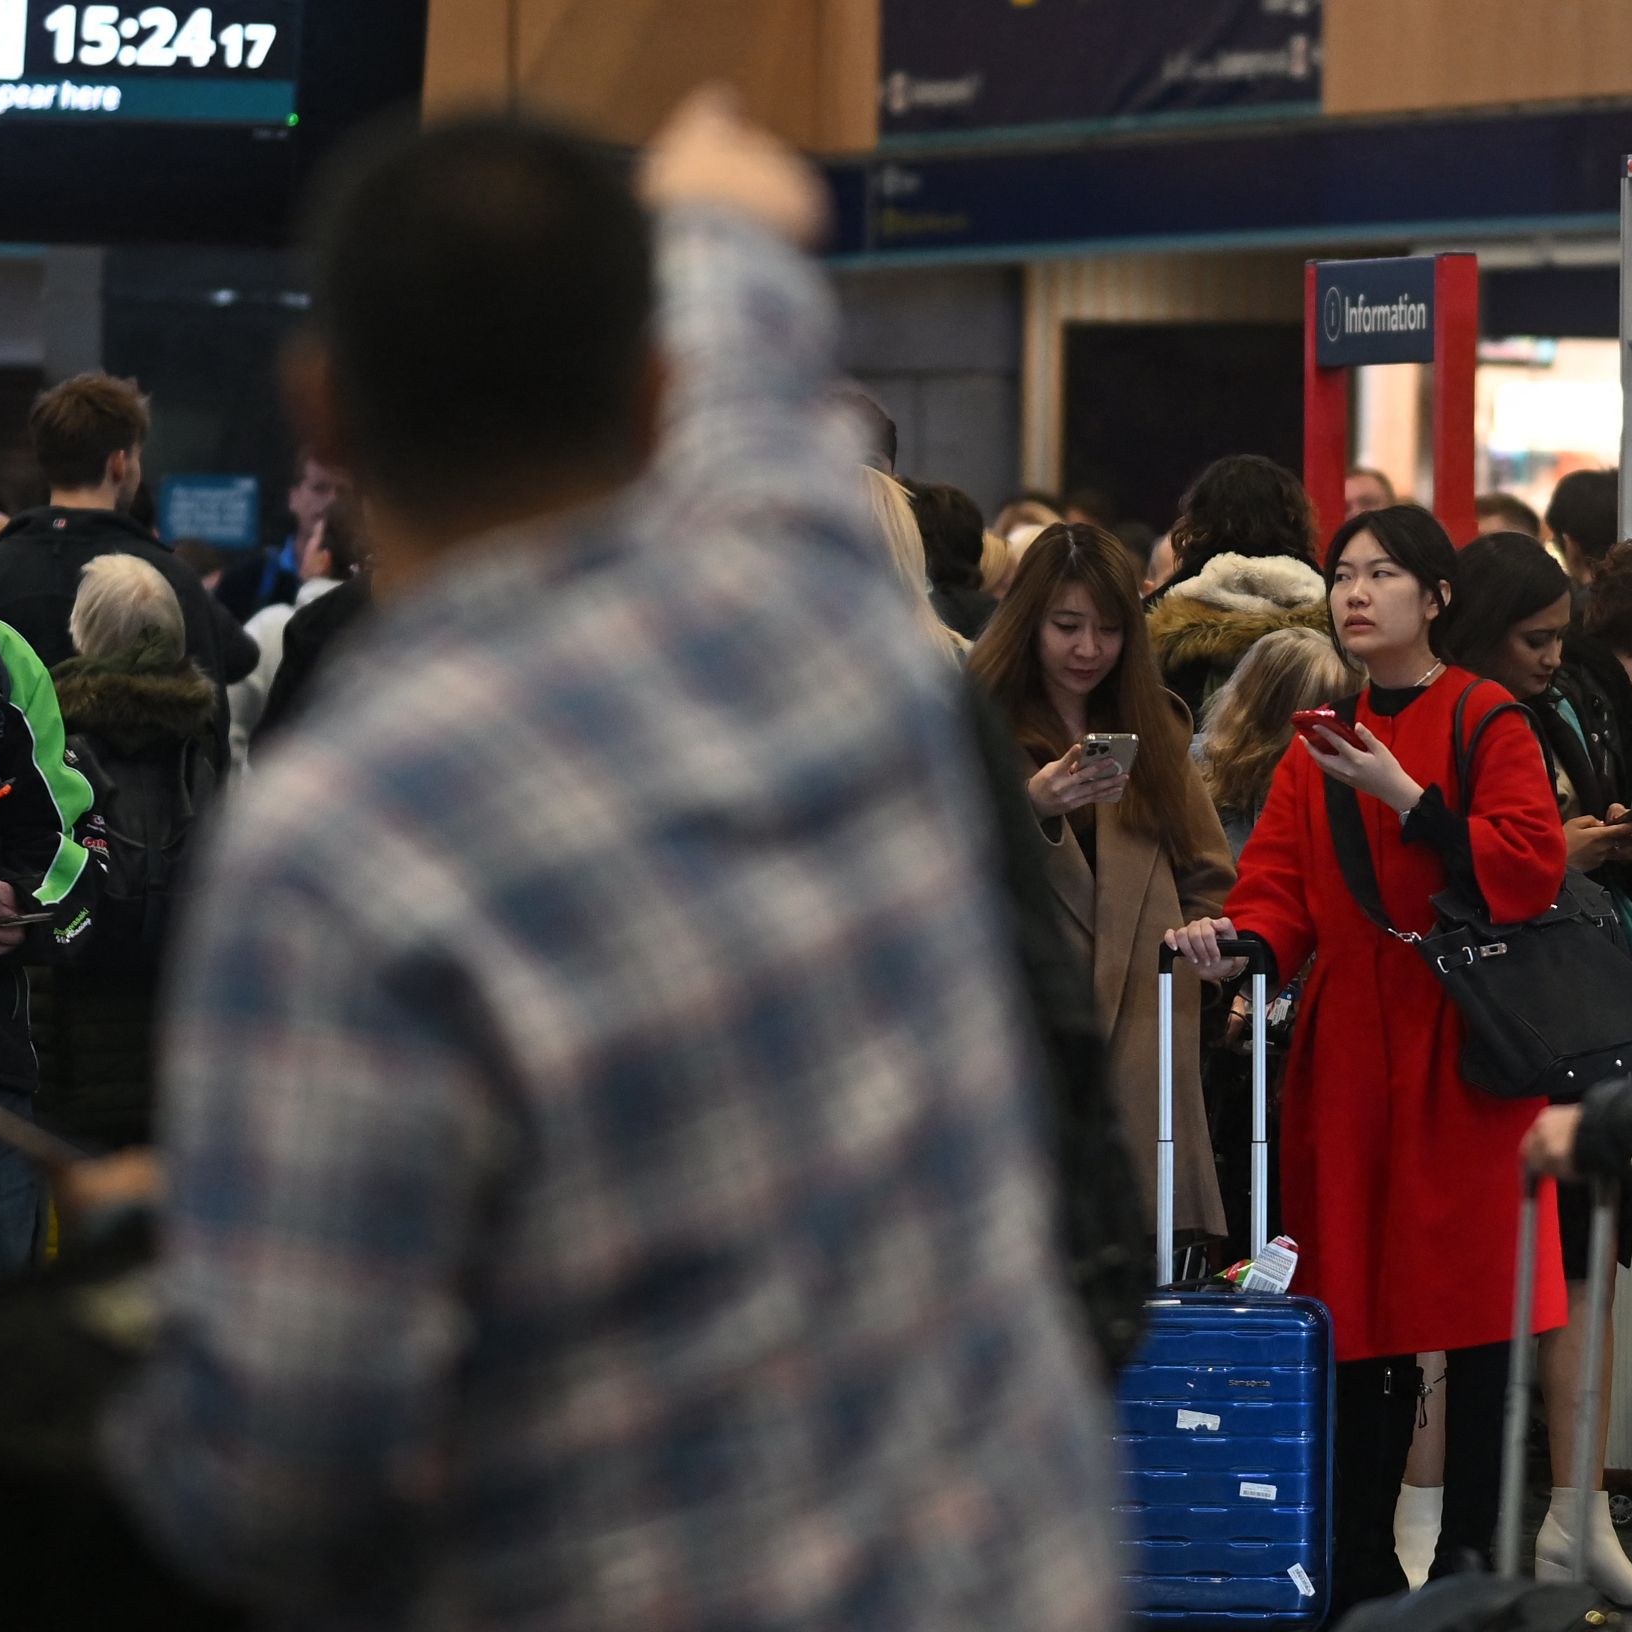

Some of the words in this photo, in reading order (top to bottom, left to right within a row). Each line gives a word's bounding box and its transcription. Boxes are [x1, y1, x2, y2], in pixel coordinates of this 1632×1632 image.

[45, 4, 216, 69] 15:24
[219, 24, 277, 69] 17
[61, 79, 121, 112] here
[1344, 293, 1427, 335] Information
